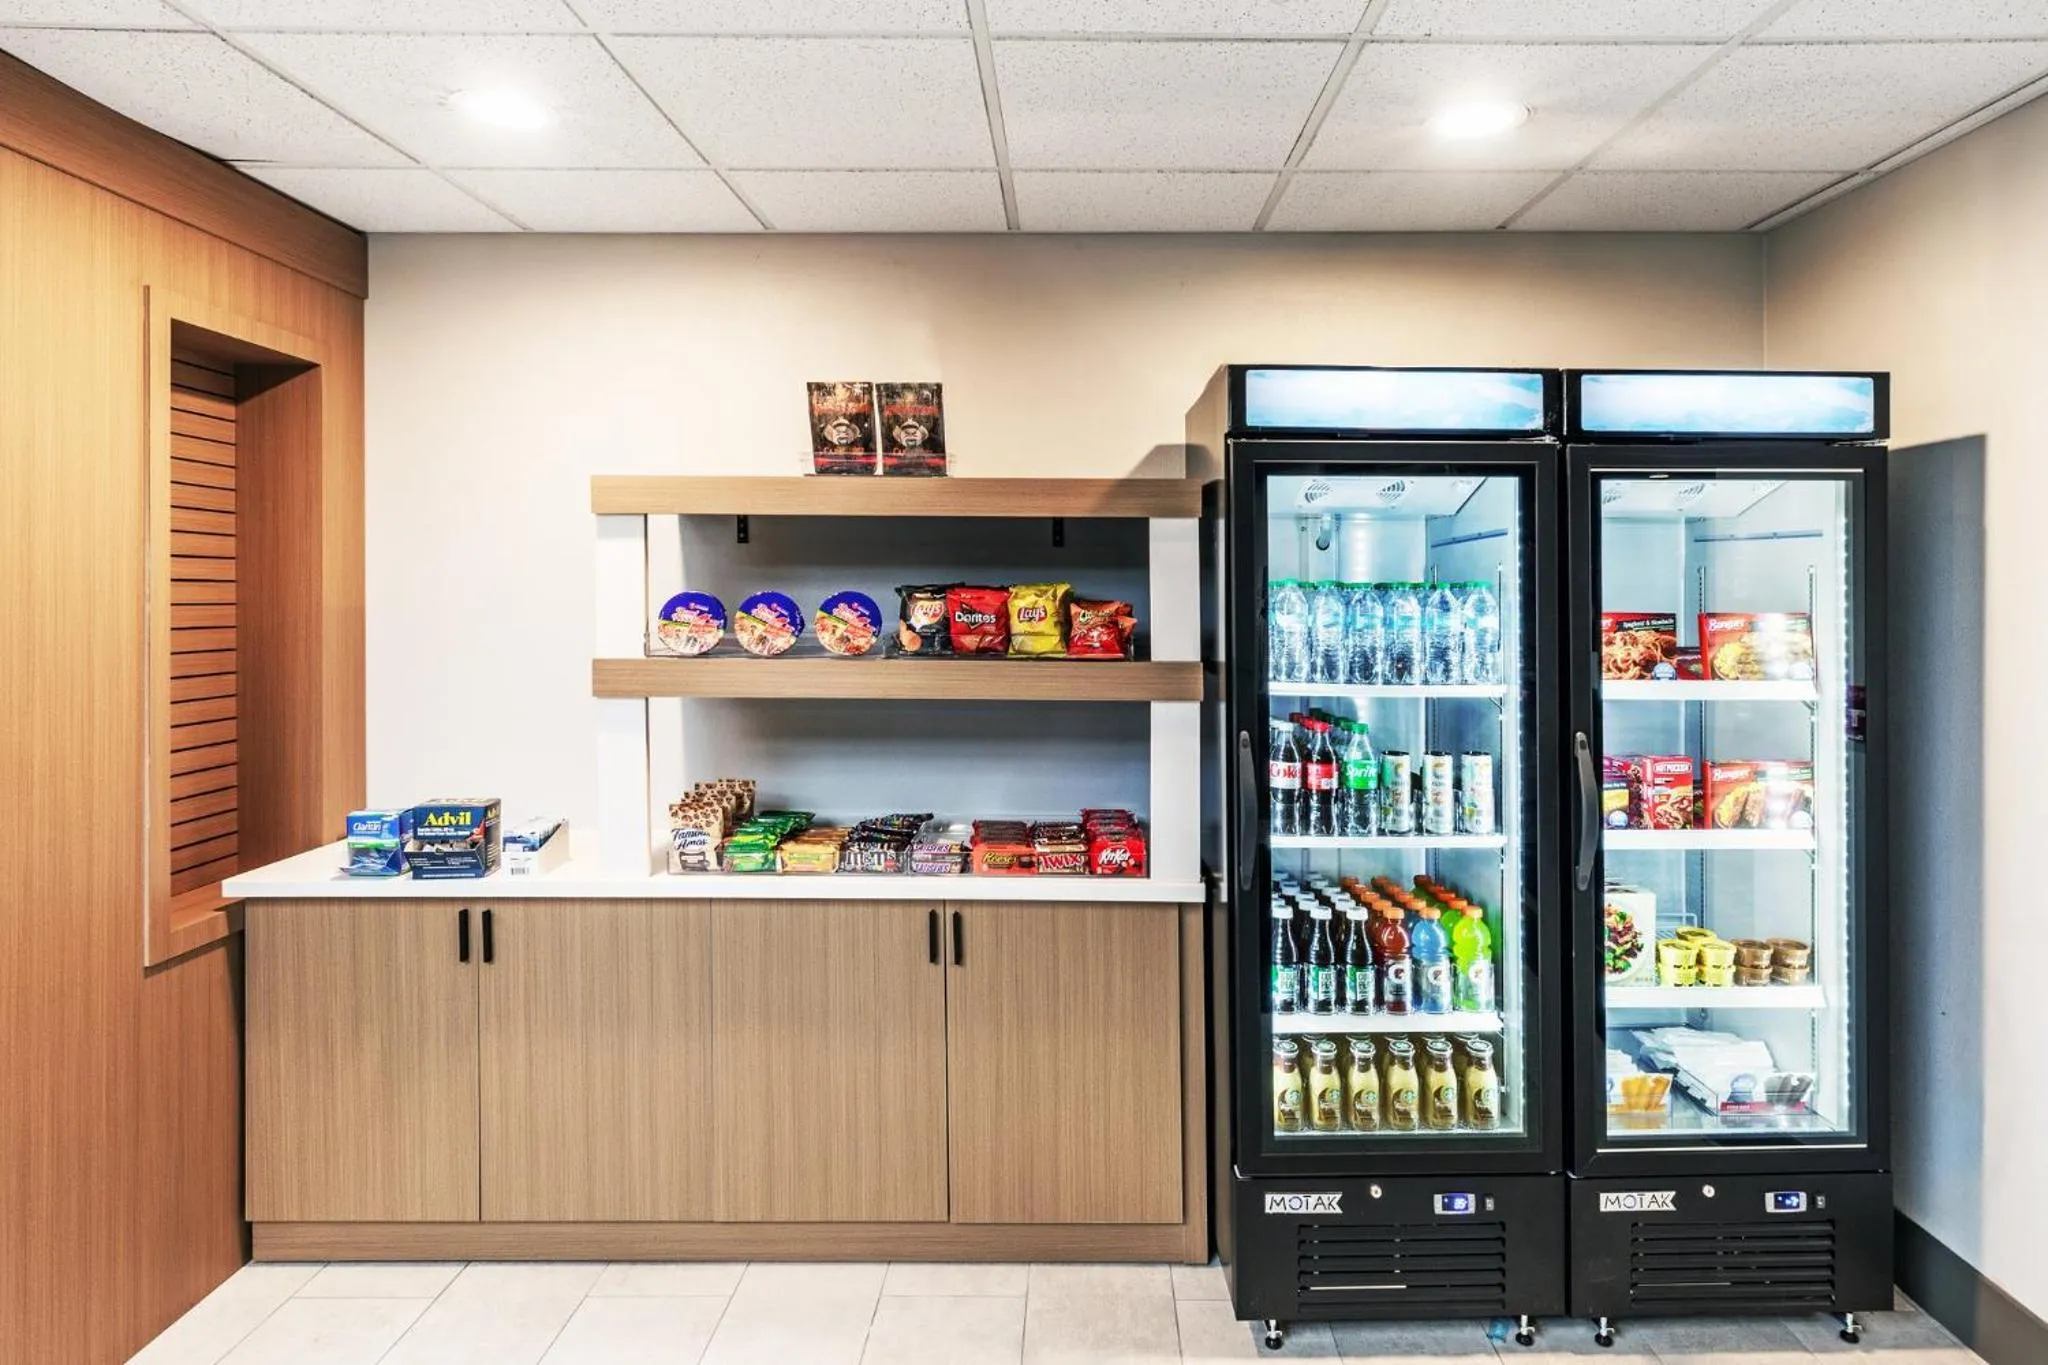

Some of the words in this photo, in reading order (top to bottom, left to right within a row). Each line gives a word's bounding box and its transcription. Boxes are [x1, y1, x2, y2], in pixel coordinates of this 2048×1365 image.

[955, 611, 996, 624] Doritos
[1346, 764, 1378, 778] Sprite
[424, 811, 471, 826] Advil
[1269, 1195, 1337, 1211] MOTAK
[1604, 1194, 1672, 1209] MOTAK
